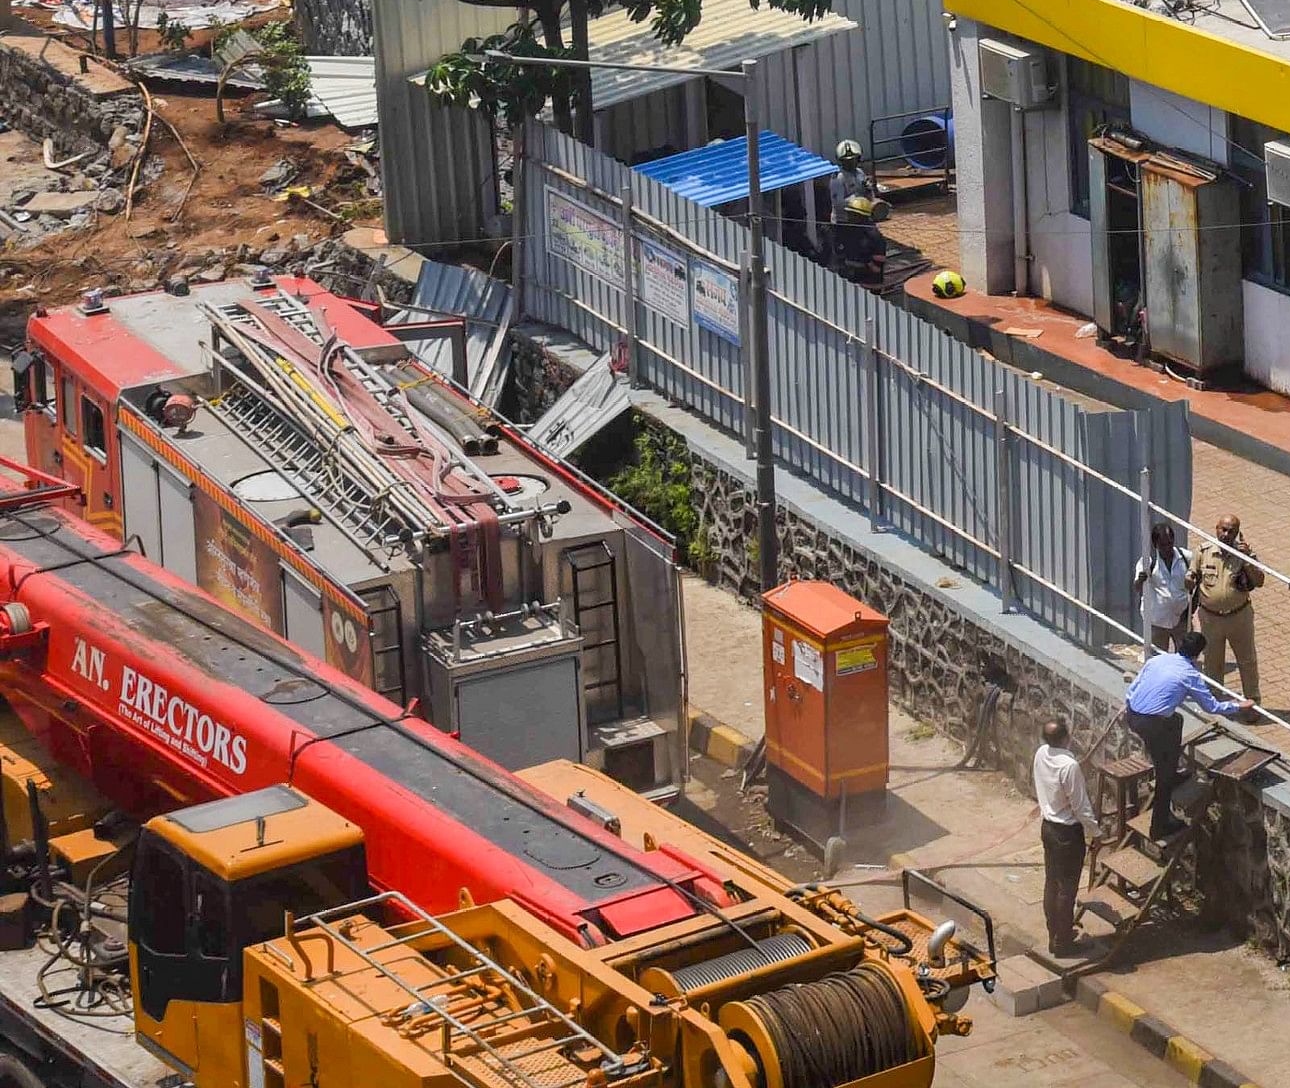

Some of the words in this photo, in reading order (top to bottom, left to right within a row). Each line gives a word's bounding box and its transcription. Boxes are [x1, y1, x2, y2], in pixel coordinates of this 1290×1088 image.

[72, 637, 110, 691] AN.
[119, 665, 247, 775] ERECTORS
[132, 710, 143, 726] Art
